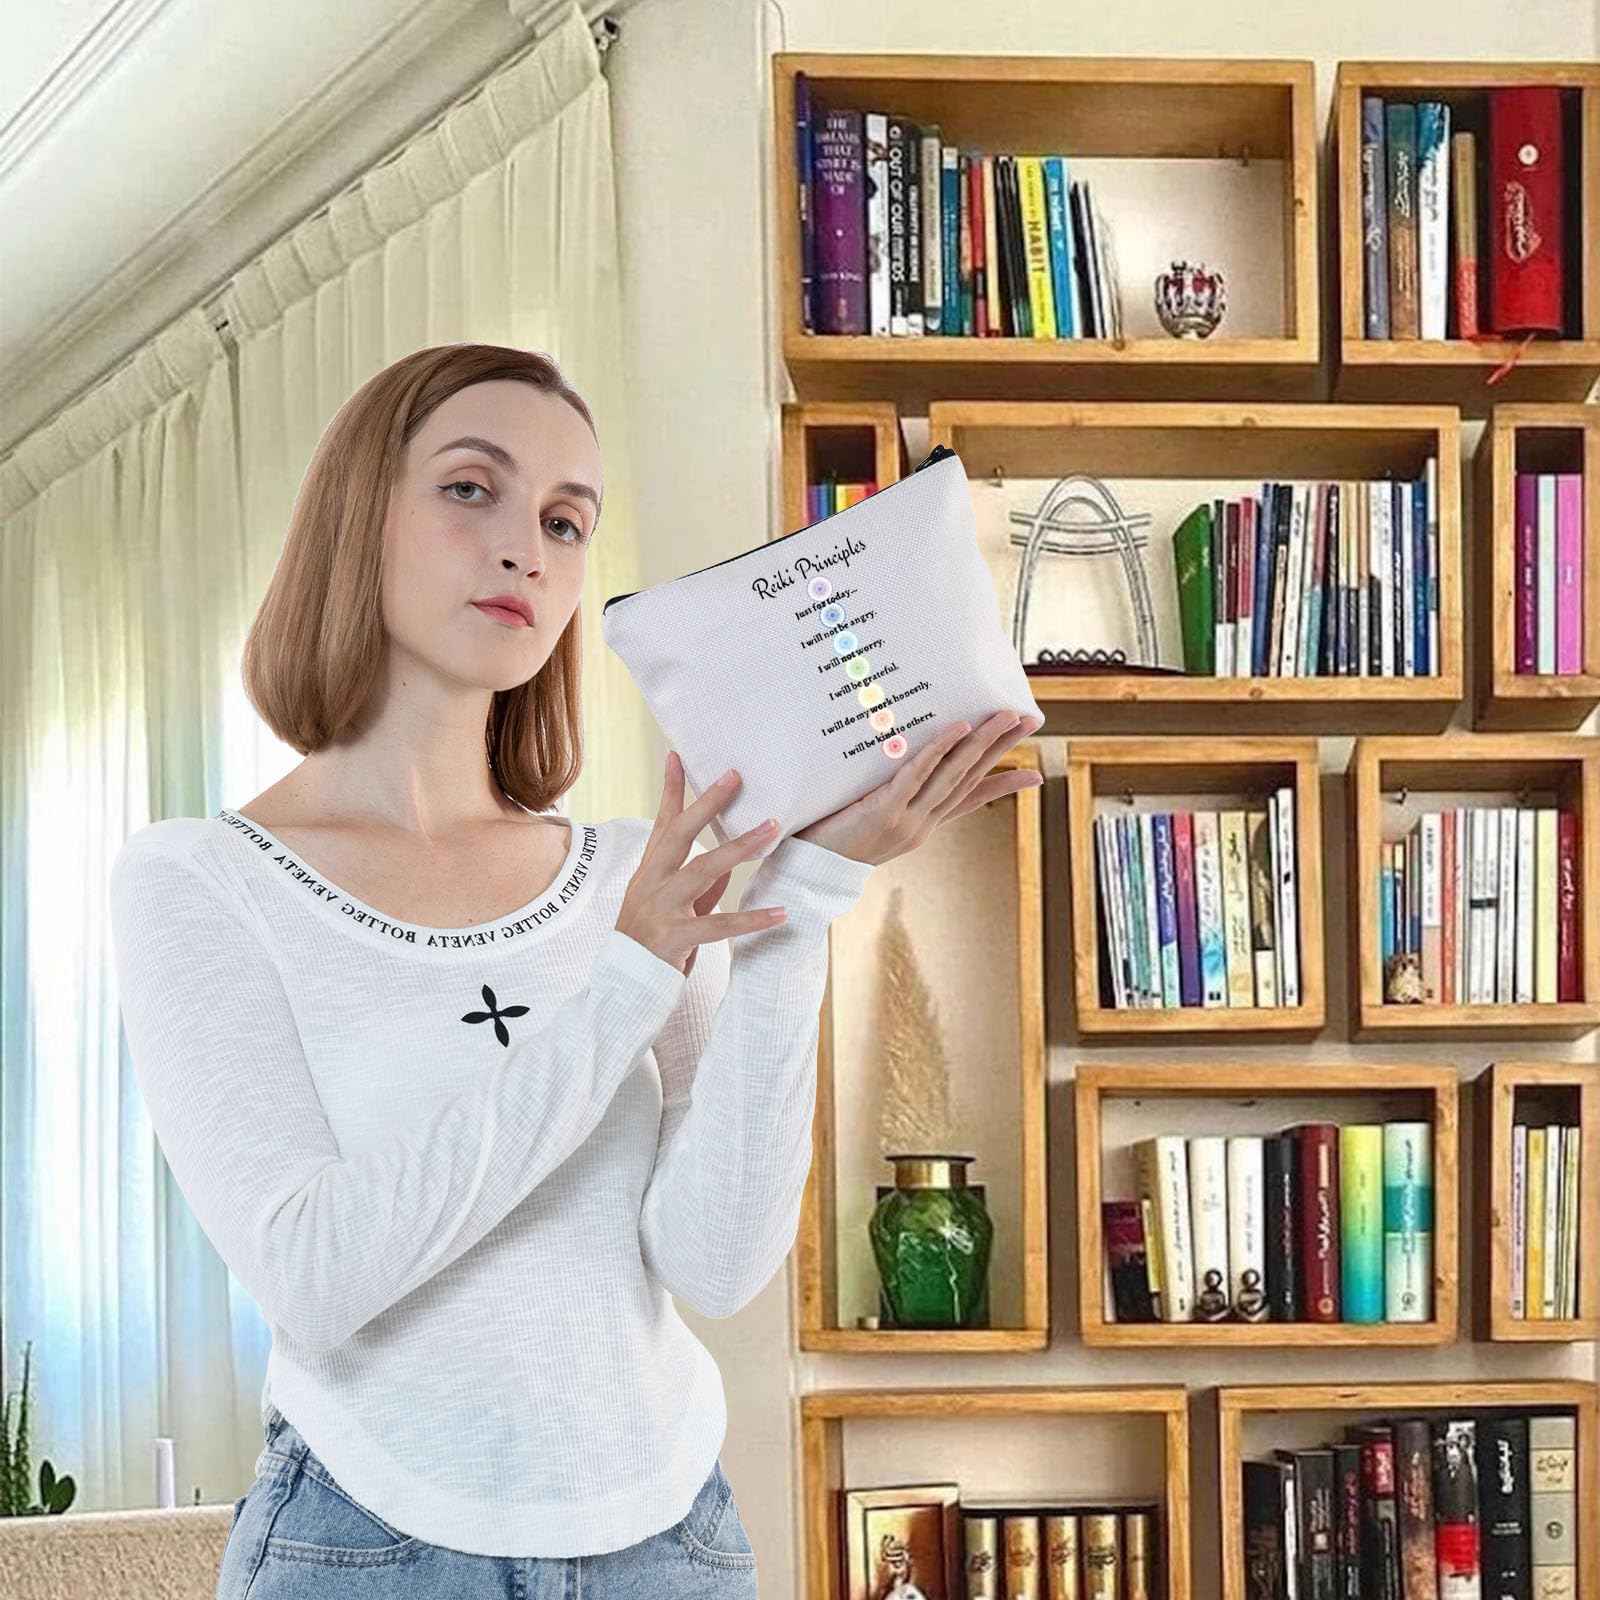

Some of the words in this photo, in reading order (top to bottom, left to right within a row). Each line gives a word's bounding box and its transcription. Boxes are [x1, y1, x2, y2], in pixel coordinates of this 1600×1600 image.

[888, 147, 902, 177] OUT
[890, 179, 903, 201] OF
[891, 203, 904, 234] OUR
[1028, 221, 1046, 273] HABIT
[752, 569, 795, 600] Reiki
[795, 538, 866, 579] Principles
[796, 608, 812, 620] Just
[813, 601, 827, 612] for
[801, 641, 805, 649] I
[806, 632, 823, 646] will
[824, 627, 838, 639] not
[838, 623, 849, 631] be
[849, 612, 878, 629] angry.
[823, 657, 840, 671] will
[841, 650, 856, 664] not
[856, 639, 886, 656] worry.
[835, 684, 851, 699] will
[851, 681, 862, 690] be
[863, 664, 899, 687] grateful.
[827, 721, 843, 734] will
[844, 716, 855, 726] do
[856, 710, 870, 721] my
[870, 697, 893, 714] work
[893, 681, 932, 703] honestly.
[843, 751, 848, 759] I
[848, 742, 864, 756] will
[864, 736, 876, 748] be
[876, 728, 895, 744] kind
[895, 726, 906, 735] to
[907, 712, 936, 729] others.
